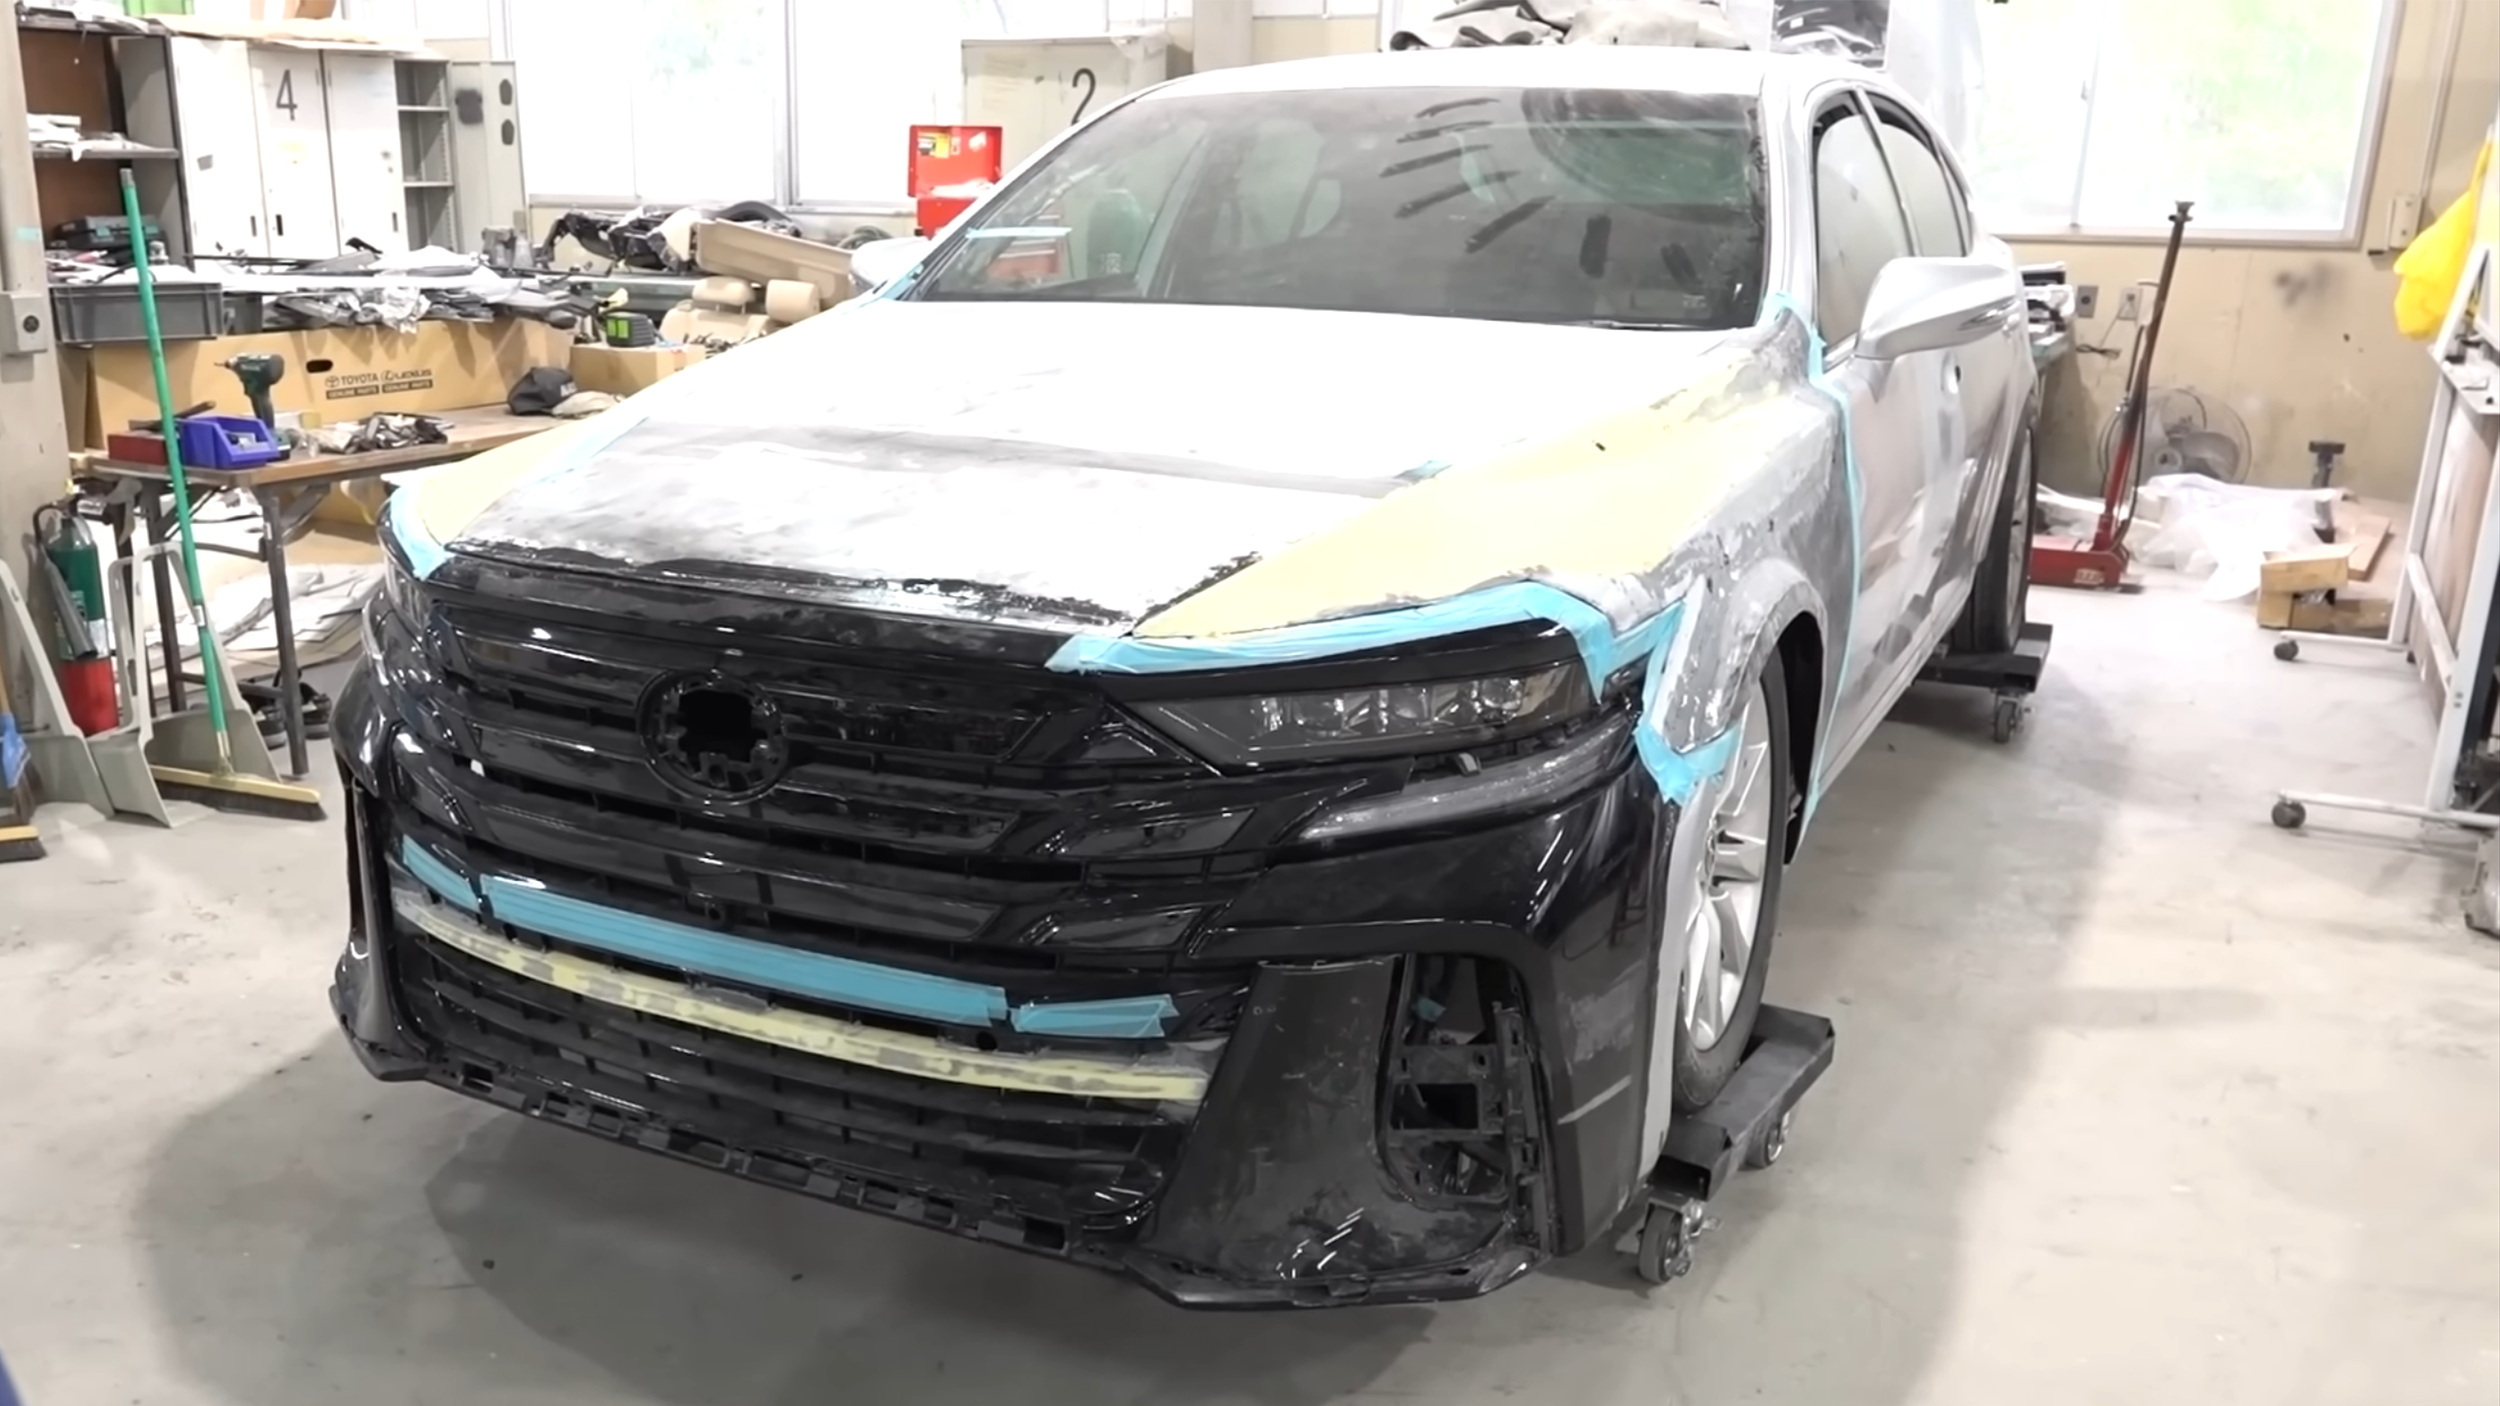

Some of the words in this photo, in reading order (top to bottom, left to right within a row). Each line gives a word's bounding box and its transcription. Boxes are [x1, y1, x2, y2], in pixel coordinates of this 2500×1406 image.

[276, 69, 297, 121] 4
[1071, 67, 1096, 126] 2
[341, 373, 379, 385] TOYOTA
